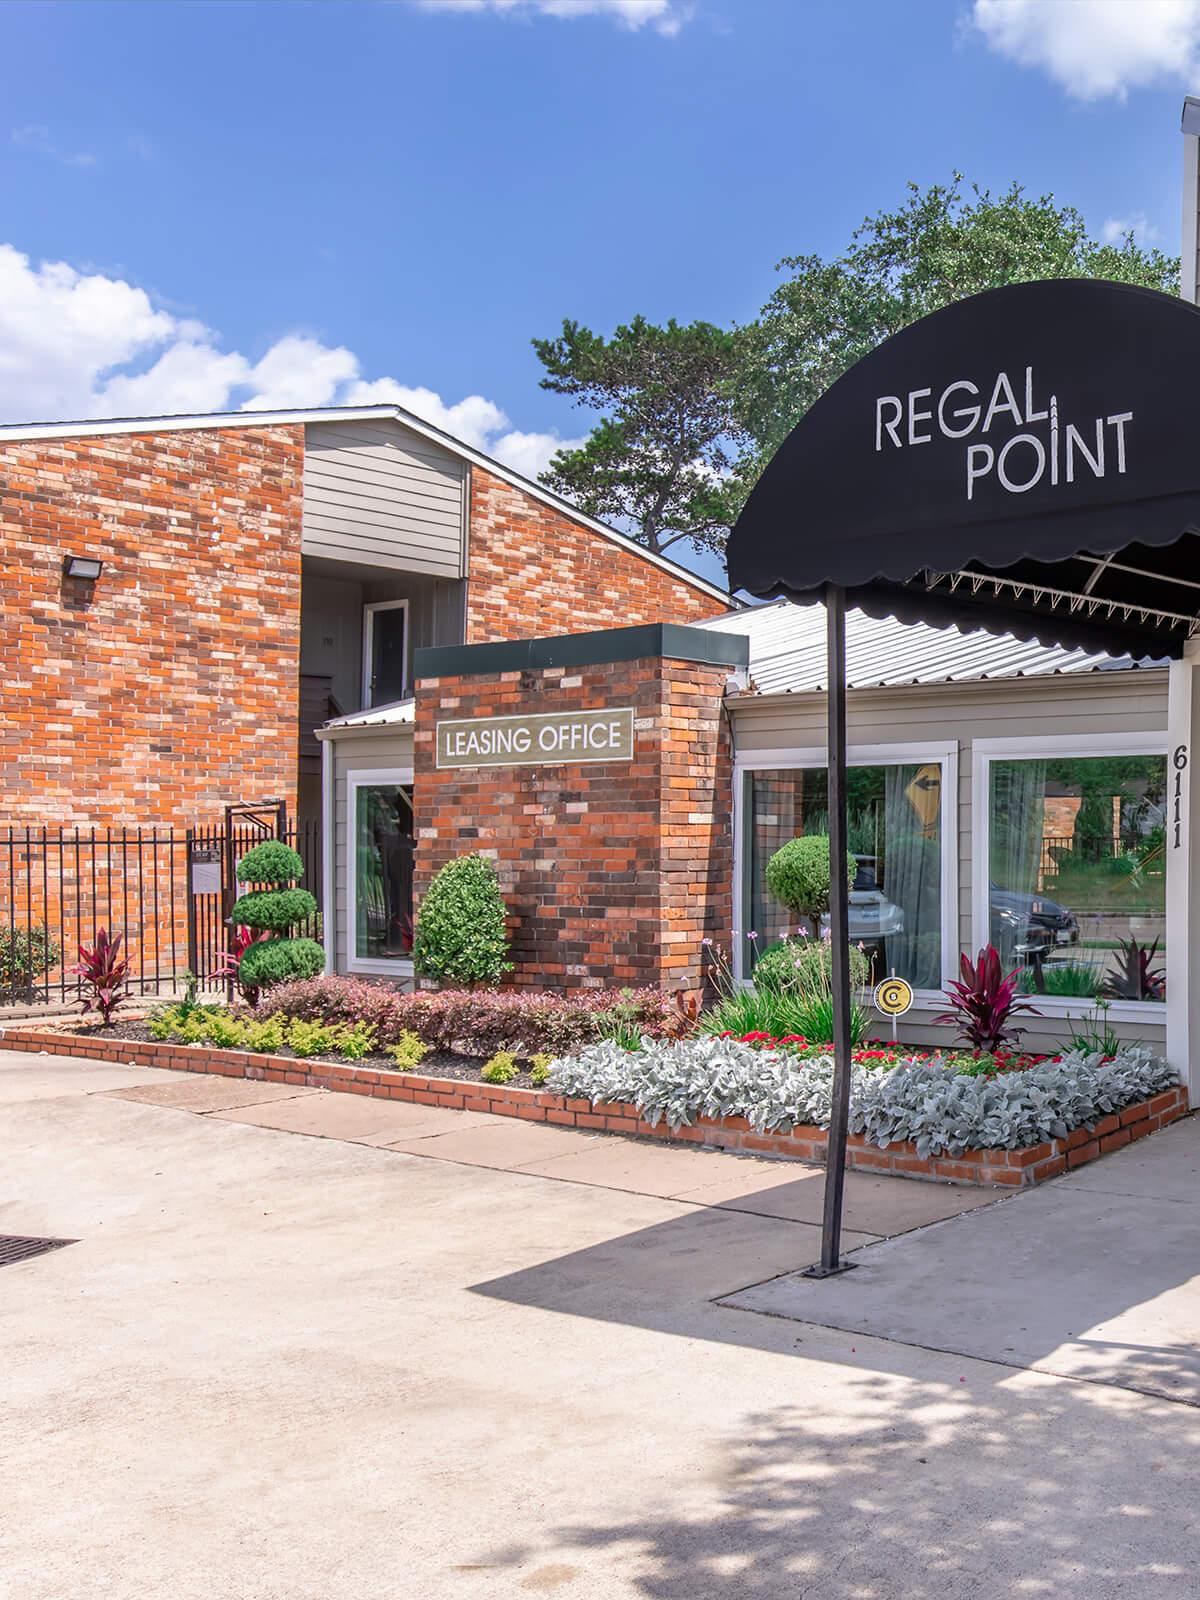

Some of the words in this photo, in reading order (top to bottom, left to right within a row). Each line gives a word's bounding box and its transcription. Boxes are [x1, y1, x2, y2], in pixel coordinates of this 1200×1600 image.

[875, 366, 1049, 451] REGAL
[967, 394, 1133, 500] POINT
[446, 727, 532, 756] LEASING
[538, 722, 621, 751] OFFICE
[1173, 744, 1188, 849] 6111
